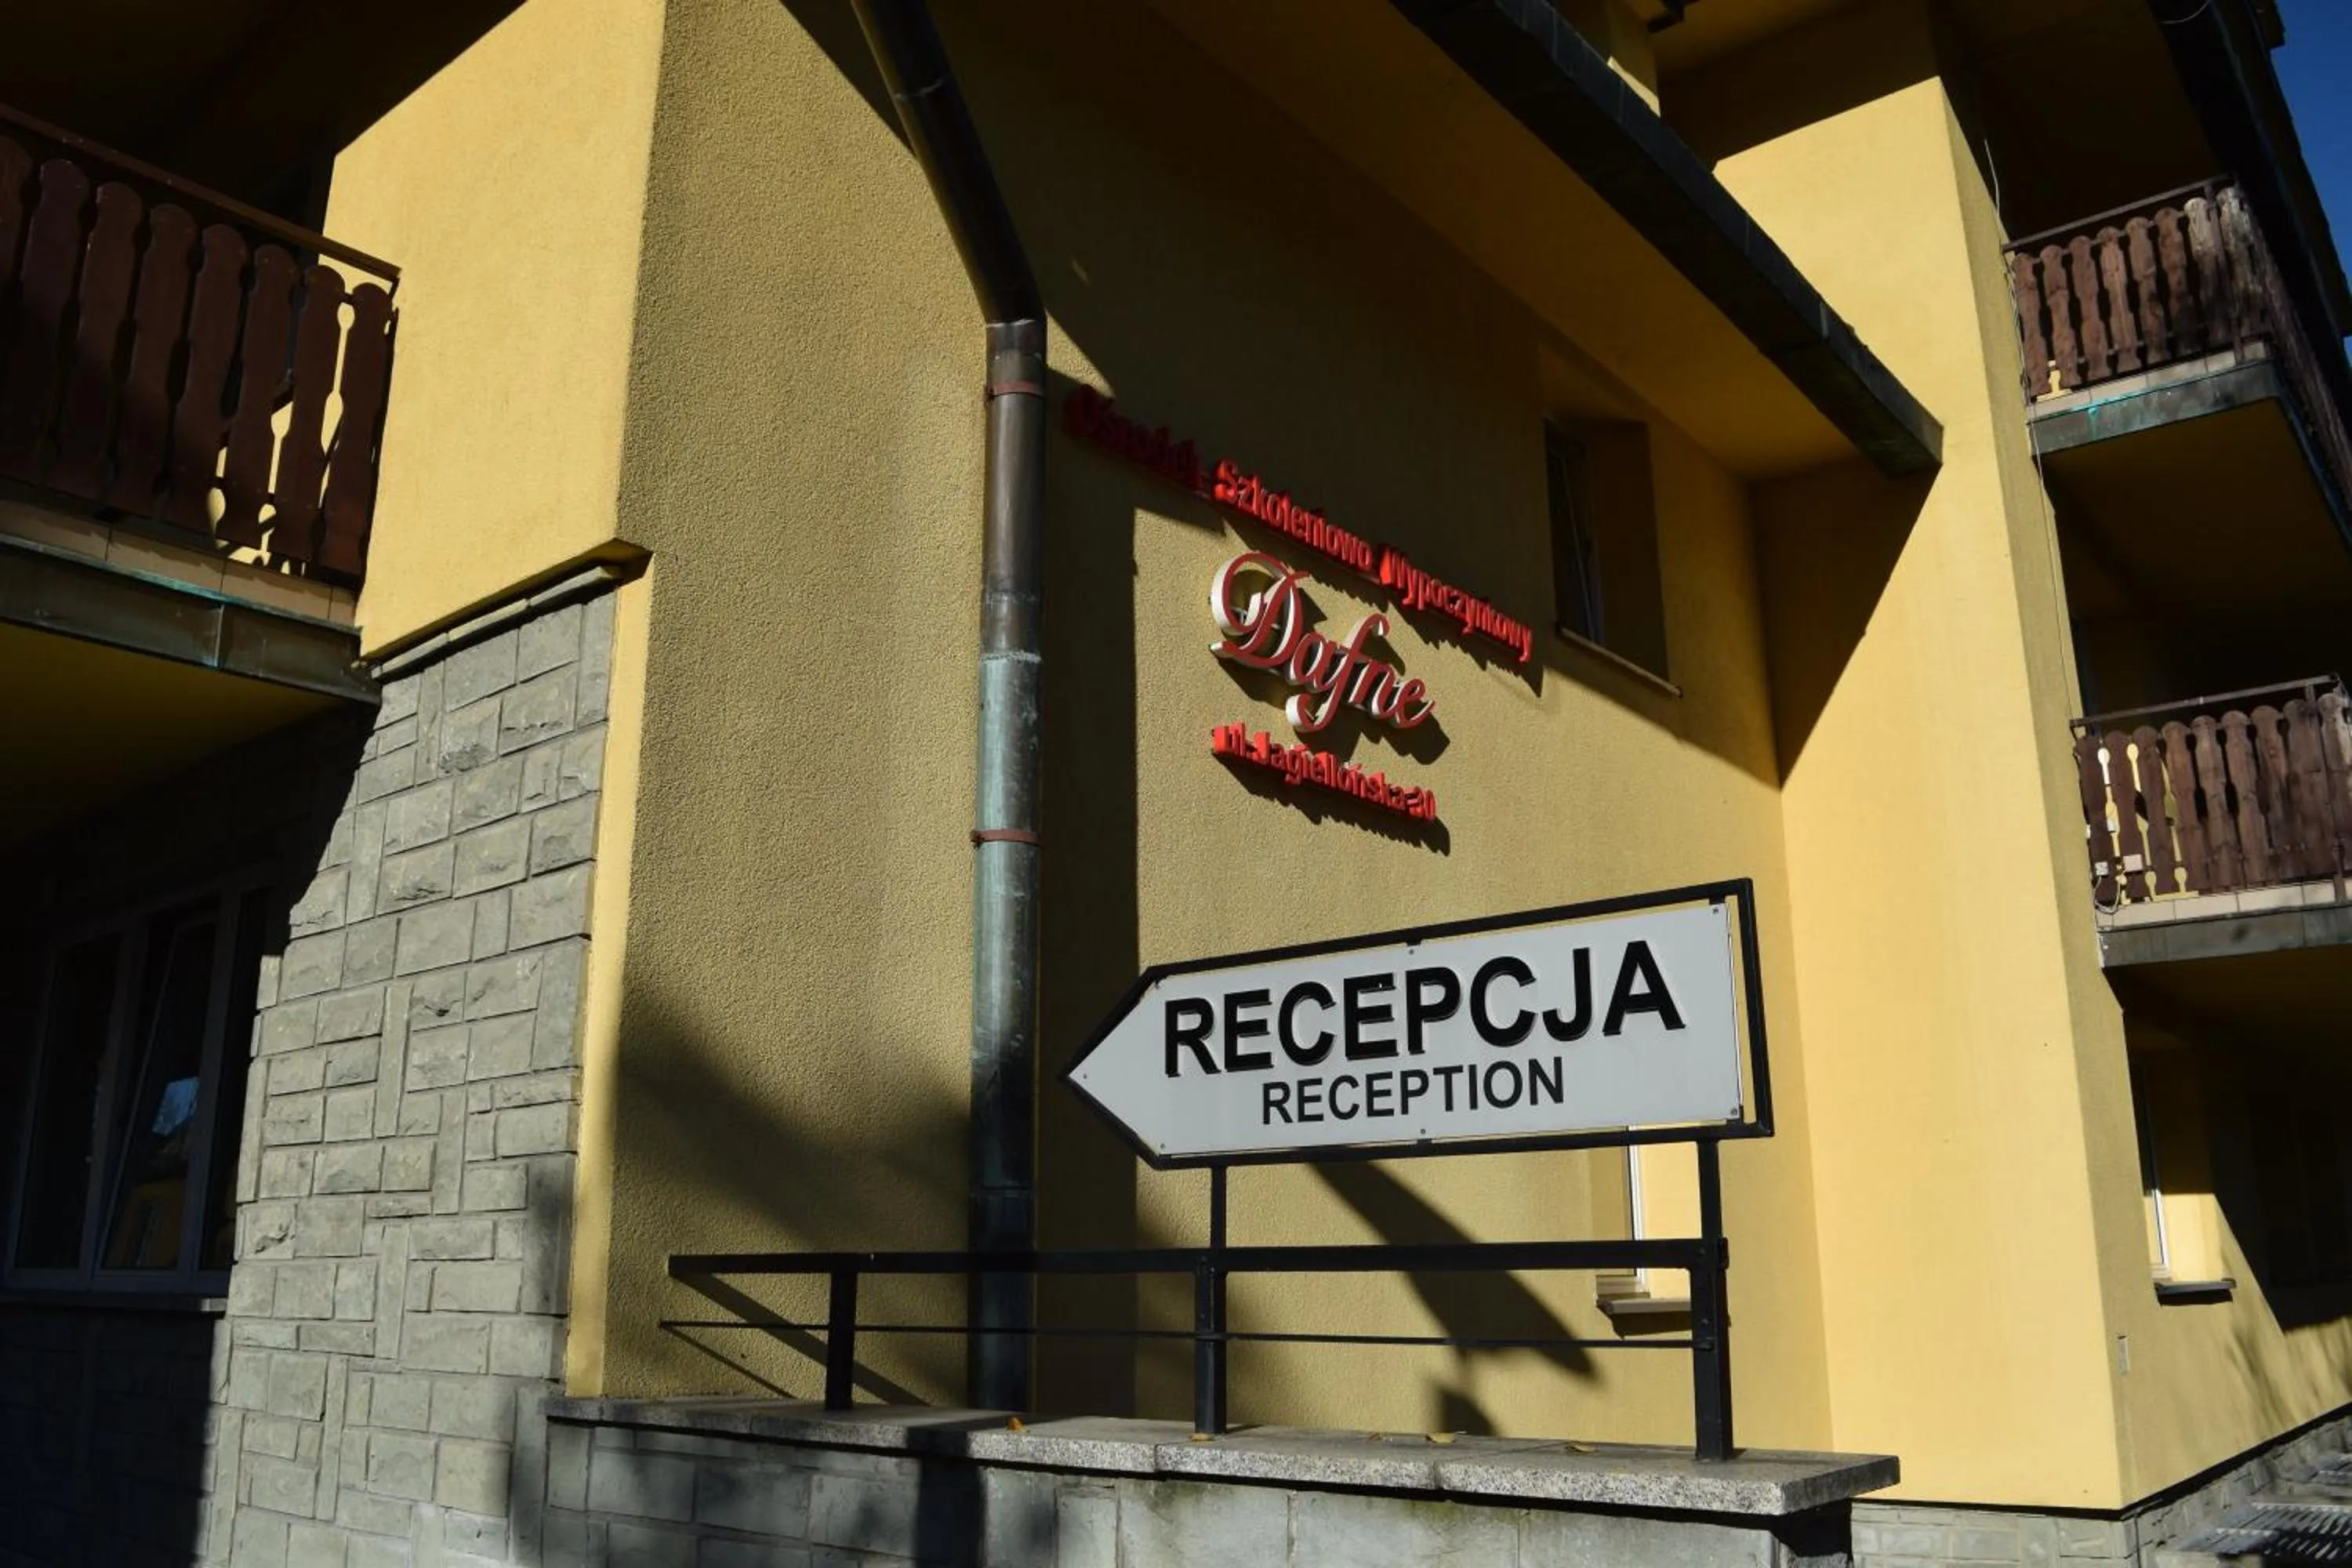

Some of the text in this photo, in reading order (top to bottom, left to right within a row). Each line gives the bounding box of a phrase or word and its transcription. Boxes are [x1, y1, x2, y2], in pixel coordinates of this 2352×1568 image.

[1209, 550, 1436, 733] Dafne
[1164, 940, 1686, 1078] RECEPCJA
[1261, 1056, 1565, 1125] RECEPTION
